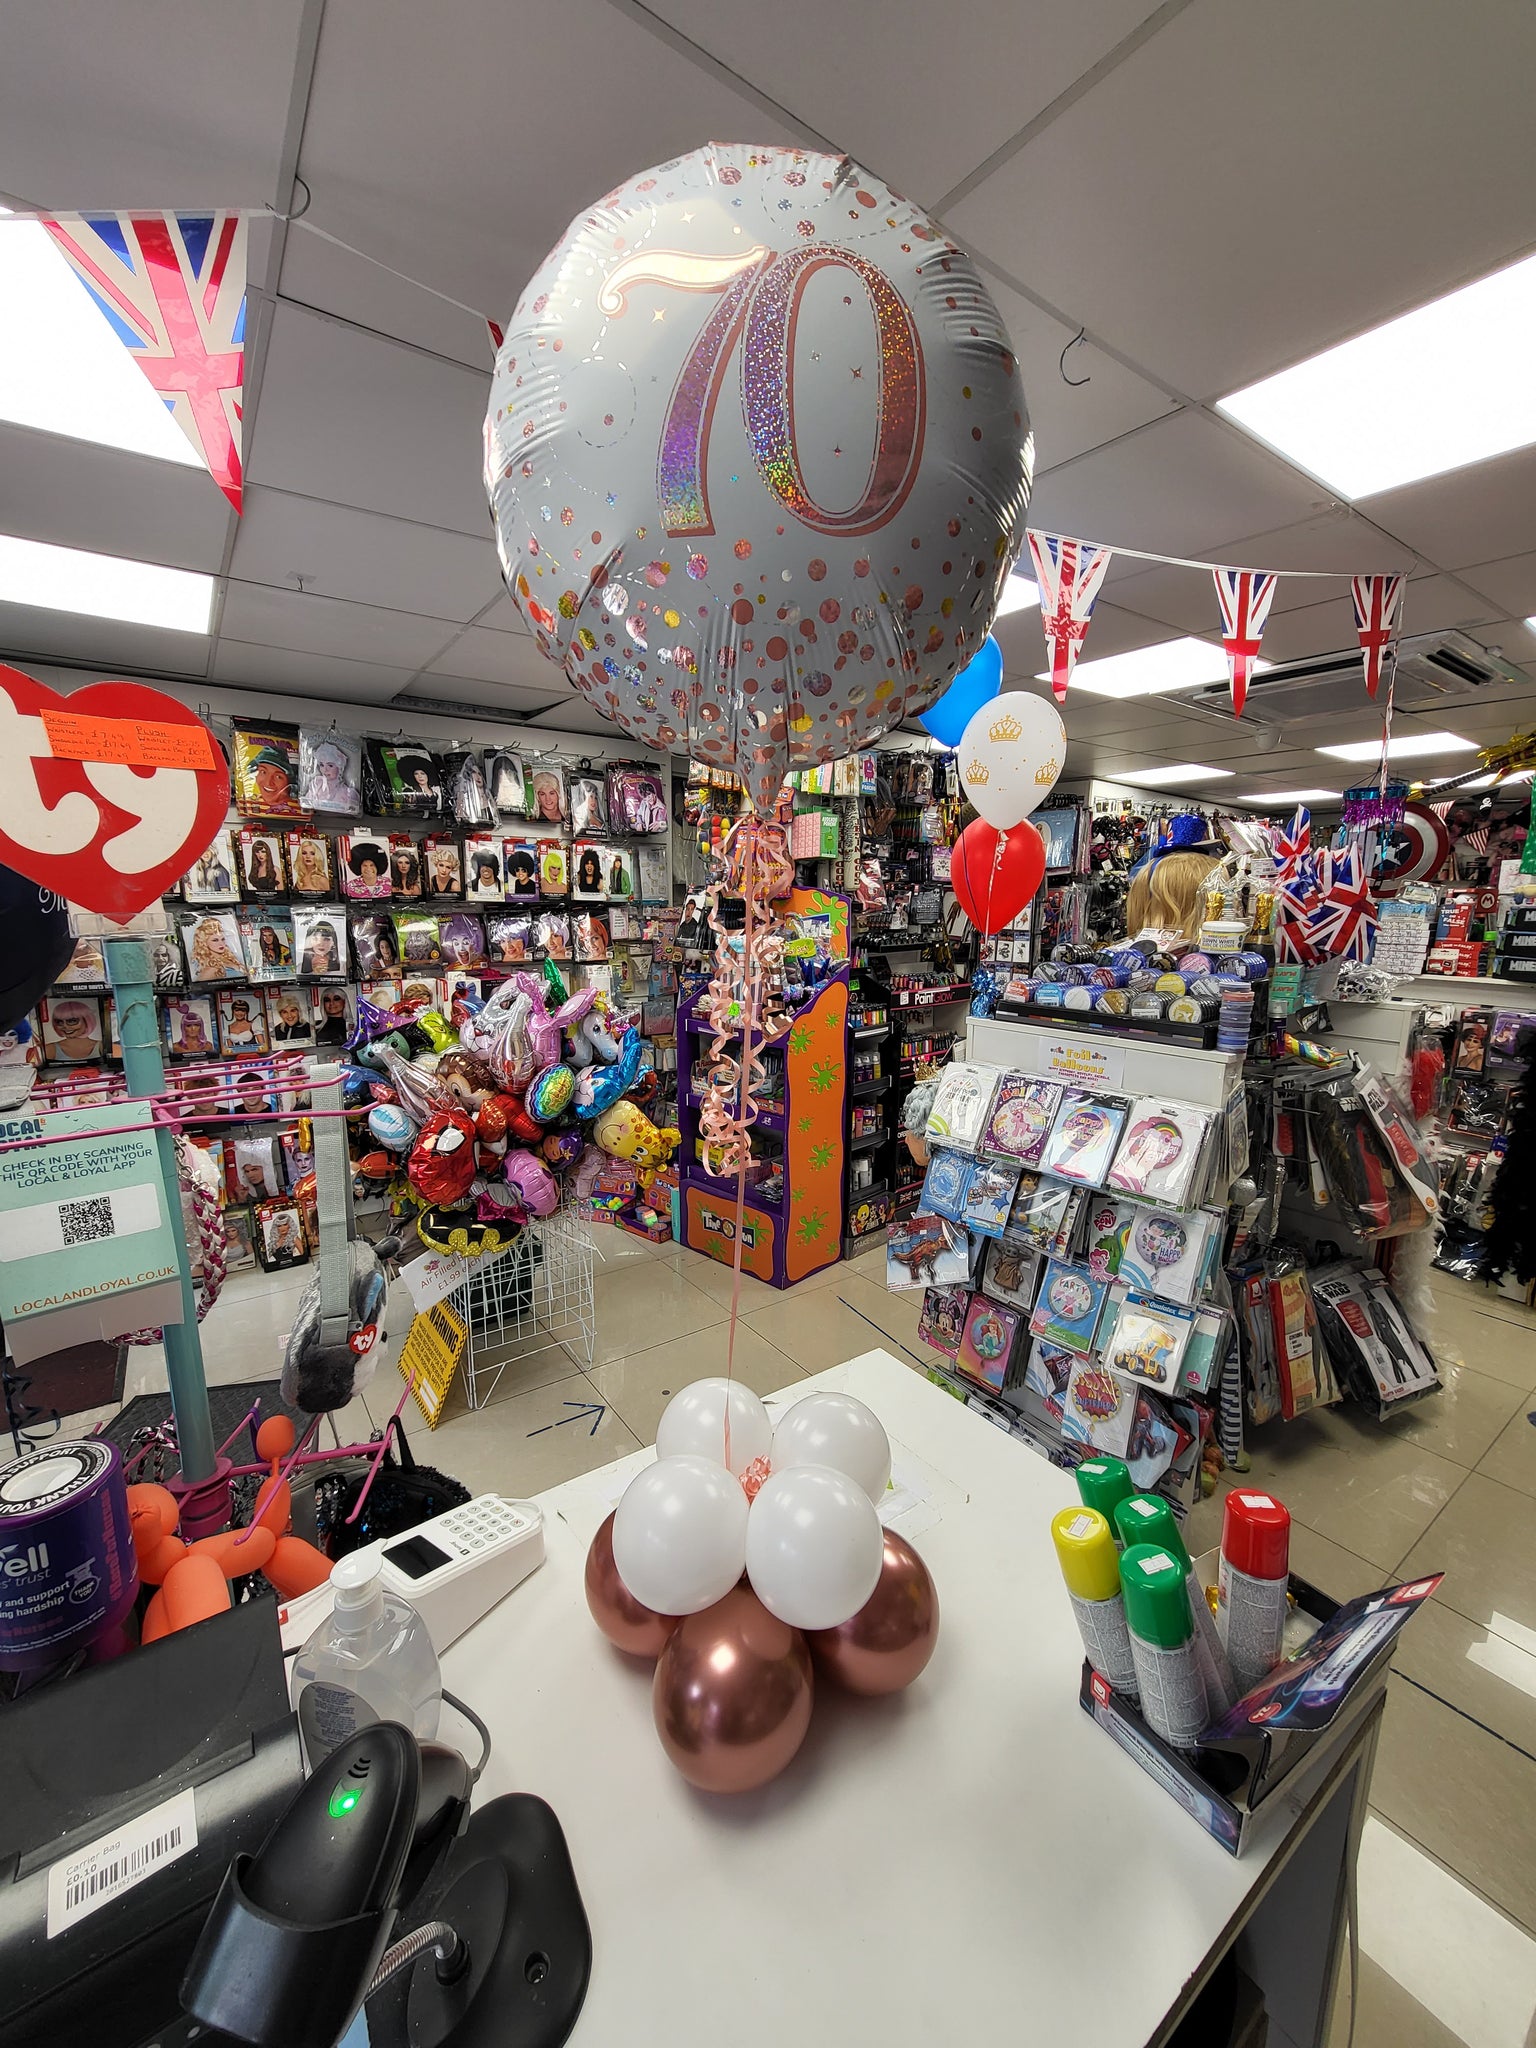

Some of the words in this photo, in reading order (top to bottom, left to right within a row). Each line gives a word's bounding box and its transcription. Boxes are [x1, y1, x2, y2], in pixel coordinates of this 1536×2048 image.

[597, 244, 926, 538] 70
[1443, 917, 1465, 925] FALSE
[1052, 1058, 1104, 1074] Balloons
[1066, 1048, 1091, 1060] Foil
[2, 1158, 46, 1173] CHECK
[49, 1154, 62, 1165] IN
[65, 1151, 80, 1163] BY
[84, 1142, 144, 1159] SCANNING
[28, 1167, 46, 1179] QR
[50, 1161, 84, 1176] CODE
[86, 1154, 119, 1167] WITH
[122, 1148, 153, 1161] YOUR
[17, 1174, 59, 1189] LOCAL
[62, 1171, 71, 1180] &
[73, 1164, 110, 1179] LOYAL
[113, 1160, 136, 1172] APP
[421, 1277, 433, 1289] Air
[434, 1259, 457, 1279] Filled
[438, 1270, 461, 1291] £1.99
[1059, 1278, 1088, 1295] PARTY
[13, 1265, 176, 1315] LOCALANDLOYAL.CO.UK
[1149, 1301, 1177, 1315] Qualatex
[429, 1305, 459, 1354] WARNING
[8, 1447, 81, 1474] SUPPORT
[33, 1475, 91, 1507] THANK
[0, 1542, 49, 1577] ell
[15, 1568, 52, 1587] trust
[5, 1596, 24, 1607] and
[26, 1580, 70, 1603] support
[16, 1595, 65, 1616] hardship
[66, 1852, 100, 1876] Carrier
[103, 1840, 121, 1855] Bag
[66, 1864, 97, 1887] £0.10
